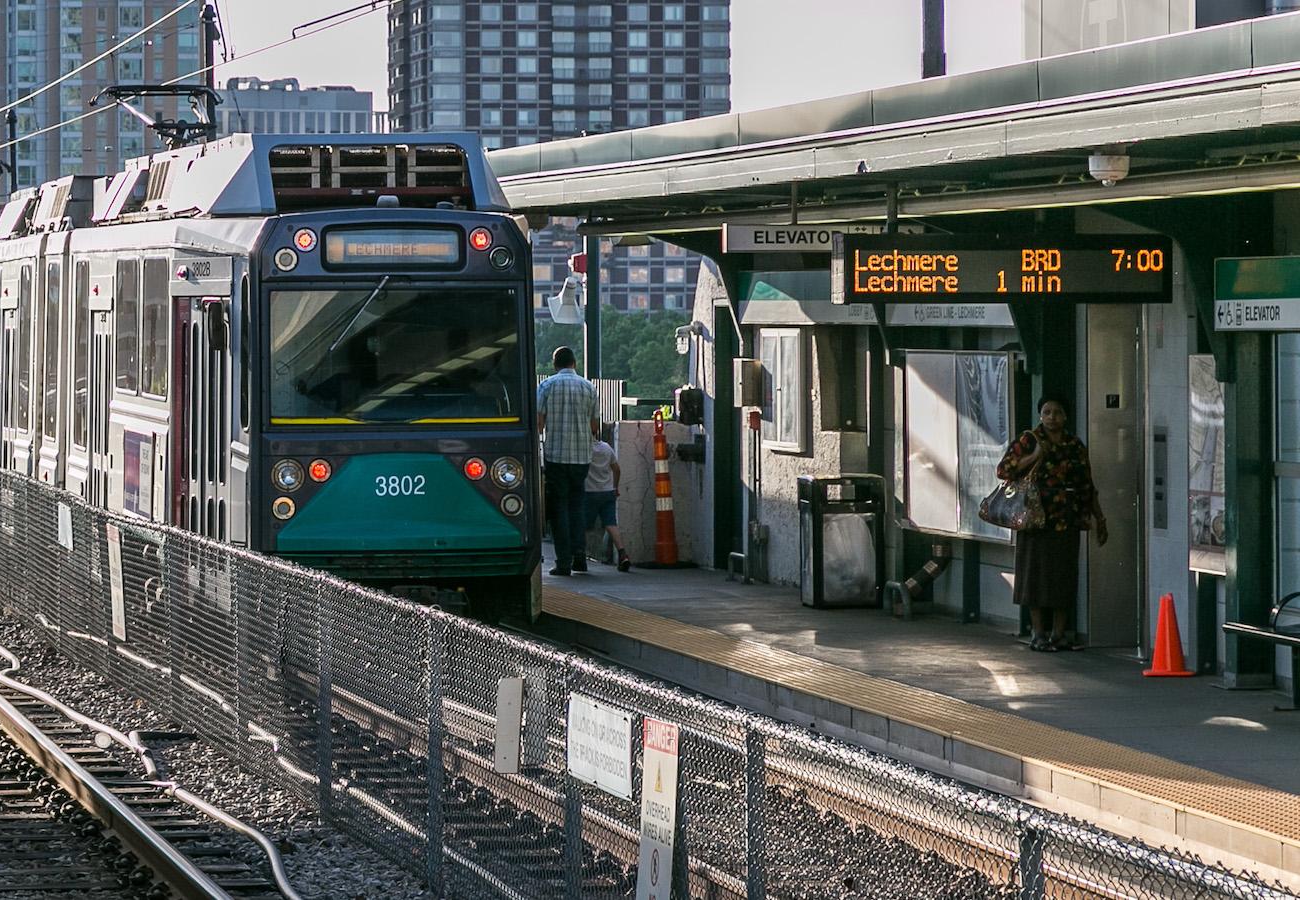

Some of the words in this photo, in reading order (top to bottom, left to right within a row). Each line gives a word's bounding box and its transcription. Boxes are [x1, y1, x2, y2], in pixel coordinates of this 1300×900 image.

[753, 230, 841, 244] ELEVATO
[192, 261, 211, 277] 3802B
[854, 249, 958, 271] Lechmere
[1021, 249, 1061, 272] BRD
[1111, 249, 1164, 272] 7:00
[854, 270, 958, 292] Lechmere
[996, 270, 1008, 293] 1
[1021, 271, 1062, 292] min
[926, 305, 943, 319] GREEN
[958, 305, 986, 320] LECHMERE
[1245, 305, 1281, 321] ELEVATOR
[375, 475, 426, 496] 3802
[647, 719, 677, 753] DANGER
[646, 799, 671, 823] OVERHEAD
[657, 825, 672, 847] ALIVE
